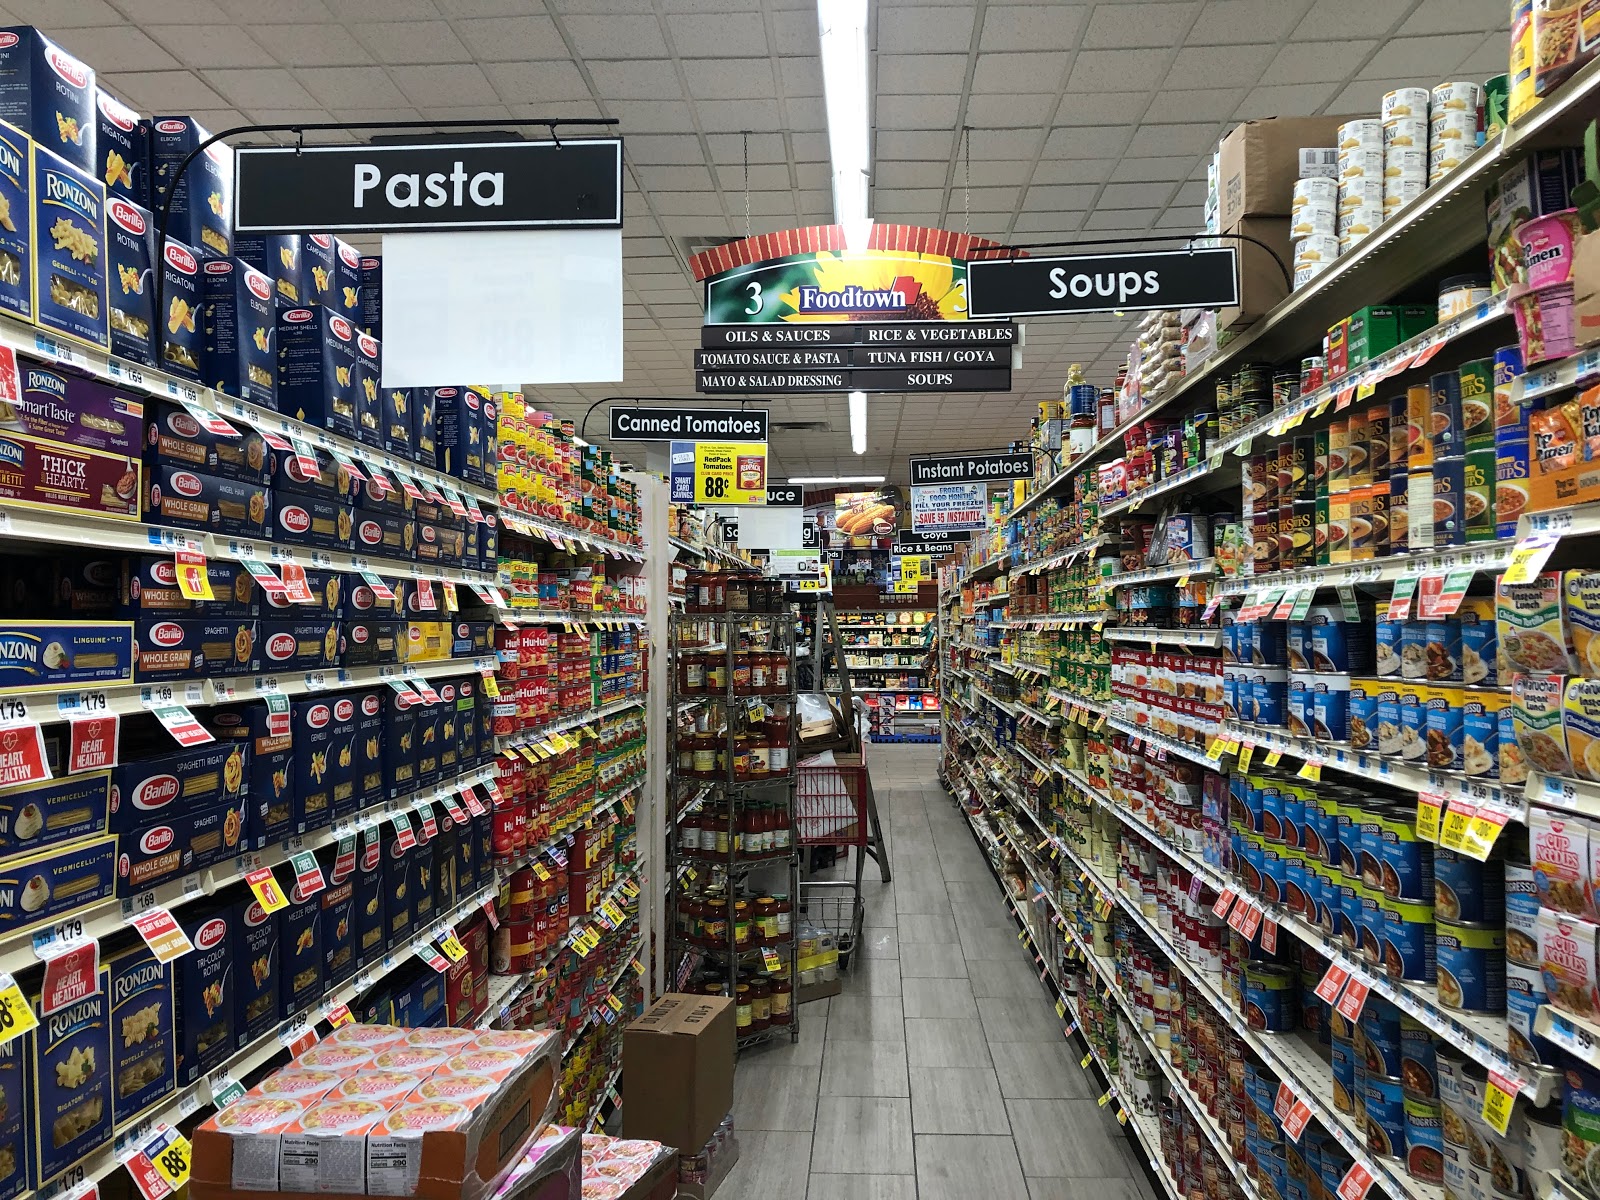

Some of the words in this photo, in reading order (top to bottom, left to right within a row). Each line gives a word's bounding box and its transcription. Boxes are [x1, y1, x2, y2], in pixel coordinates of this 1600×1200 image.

[54, 56, 86, 85] Barilla
[56, 82, 80, 105] ROTINI
[161, 123, 185, 131] Barilla
[102, 124, 132, 149] RIGATONI
[354, 162, 504, 208] Pasta
[47, 173, 98, 220] RONZONI
[115, 208, 144, 230] Barilla
[117, 232, 140, 253] ROTINI
[169, 248, 195, 269] Barilla
[208, 264, 231, 272] Barilla
[165, 270, 196, 292] RIGATONI
[251, 277, 269, 297] Barilla
[1049, 267, 1160, 303] Soups
[745, 281, 764, 315] 3
[801, 286, 907, 309] Foodtown
[250, 299, 268, 316] ELBOWS
[289, 312, 312, 321] Barilla
[334, 322, 351, 339] Barilla
[725, 331, 758, 342] OILS
[762, 331, 773, 342] &
[776, 330, 831, 342] SAUCES
[868, 329, 902, 341] RICE
[906, 329, 917, 341] &
[921, 328, 1013, 341] VEGETABLES
[701, 353, 750, 365] TOMATO
[753, 353, 790, 365] SAUCE
[793, 353, 802, 364] &
[804, 352, 841, 364] PASTA
[867, 352, 906, 363] TUNA
[910, 351, 942, 362] FISH
[953, 350, 995, 362] GOYA
[28, 371, 65, 395] RONZONI
[702, 376, 736, 387] MAYO
[738, 376, 747, 387] &
[750, 376, 785, 387] SALAD
[788, 375, 842, 387] DRESSING
[907, 373, 953, 385] SOUPS
[49, 402, 75, 424] Taste
[175, 417, 199, 432] Barilla
[618, 414, 681, 432] Canned
[685, 415, 761, 434] Tomatoes
[110, 437, 128, 447] Spaghetti
[161, 440, 185, 451] WHOLE
[186, 445, 206, 456] GRAIN
[41, 455, 86, 477] THICK
[918, 461, 964, 479] Instant
[968, 459, 1029, 476] Potatoes
[46, 473, 86, 490] HEARTY
[178, 477, 200, 490] Barilla
[219, 485, 232, 494] ANGEL
[233, 488, 245, 496] HAIR
[672, 491, 693, 499] SAVINGS
[767, 491, 796, 501] uce
[164, 500, 187, 510] WHOLE
[189, 503, 208, 514] GRAIN
[314, 504, 333, 514] SPAGHETTI
[287, 512, 308, 526] Barilla
[920, 513, 935, 523] SAVE
[947, 511, 981, 522] INSTANTLY
[365, 527, 381, 539] Barilla
[922, 532, 948, 540] Goya
[893, 545, 913, 553] Rice
[925, 544, 953, 552] Beans
[286, 580, 305, 591] GLUTEN
[144, 591, 168, 600] WHOLE
[291, 590, 306, 599] FREE
[1512, 591, 1543, 601] Instant
[1516, 601, 1540, 609] Lunch
[1500, 610, 1522, 625] Chicken
[1523, 614, 1544, 626] Tortilla
[158, 628, 182, 639] Barilla
[204, 627, 229, 635] SPAGHETTI
[273, 641, 294, 654] Barilla
[143, 653, 167, 663] WHOLE
[170, 652, 190, 662] GRAIN
[1523, 679, 1558, 692] Maruchan
[81, 693, 106, 711] $1.79
[271, 699, 285, 708] FIBER
[1524, 692, 1548, 702] Instant
[1527, 702, 1546, 711] Lunch
[313, 711, 329, 722] Barilla
[1514, 709, 1532, 725] Chicken
[262, 739, 278, 747] WHOLE
[311, 732, 327, 742] GEMELLI
[81, 739, 103, 753] HEART
[77, 752, 106, 768] HEALTHY
[177, 758, 206, 772] SPAGHETTI
[207, 754, 223, 766] RIGATI
[272, 755, 284, 763] ROTINI
[144, 781, 176, 798] Barilla
[47, 791, 88, 804] VERMICELLI
[194, 815, 218, 828] SPAGHETTI
[148, 834, 171, 847] Barilla
[1545, 832, 1571, 850] CUP
[133, 862, 157, 875] WHOLE
[159, 855, 180, 870] GRAIN
[298, 859, 313, 870] FIBER
[1536, 845, 1579, 871] NOODLES
[53, 858, 96, 875] VERMICELLI
[289, 911, 304, 922] MEZZE
[304, 903, 317, 916] PENNE
[202, 925, 225, 942] Barilla
[247, 925, 272, 944] TRI-COLOR
[252, 938, 267, 951] ROTINI
[1552, 935, 1578, 953] CUP
[197, 947, 225, 969] TRI-COLOR
[1544, 945, 1587, 976] NOODLES
[203, 962, 220, 977] ROTINI
[57, 969, 81, 990] HEART
[115, 964, 164, 1002] RONZONI
[52, 981, 86, 1008] HEALTHY
[50, 1000, 101, 1042] RONZONI
[121, 1050, 145, 1067] ROTELLE
[57, 1094, 84, 1113] RIGATONI
[161, 1147, 187, 1178] 88¢
